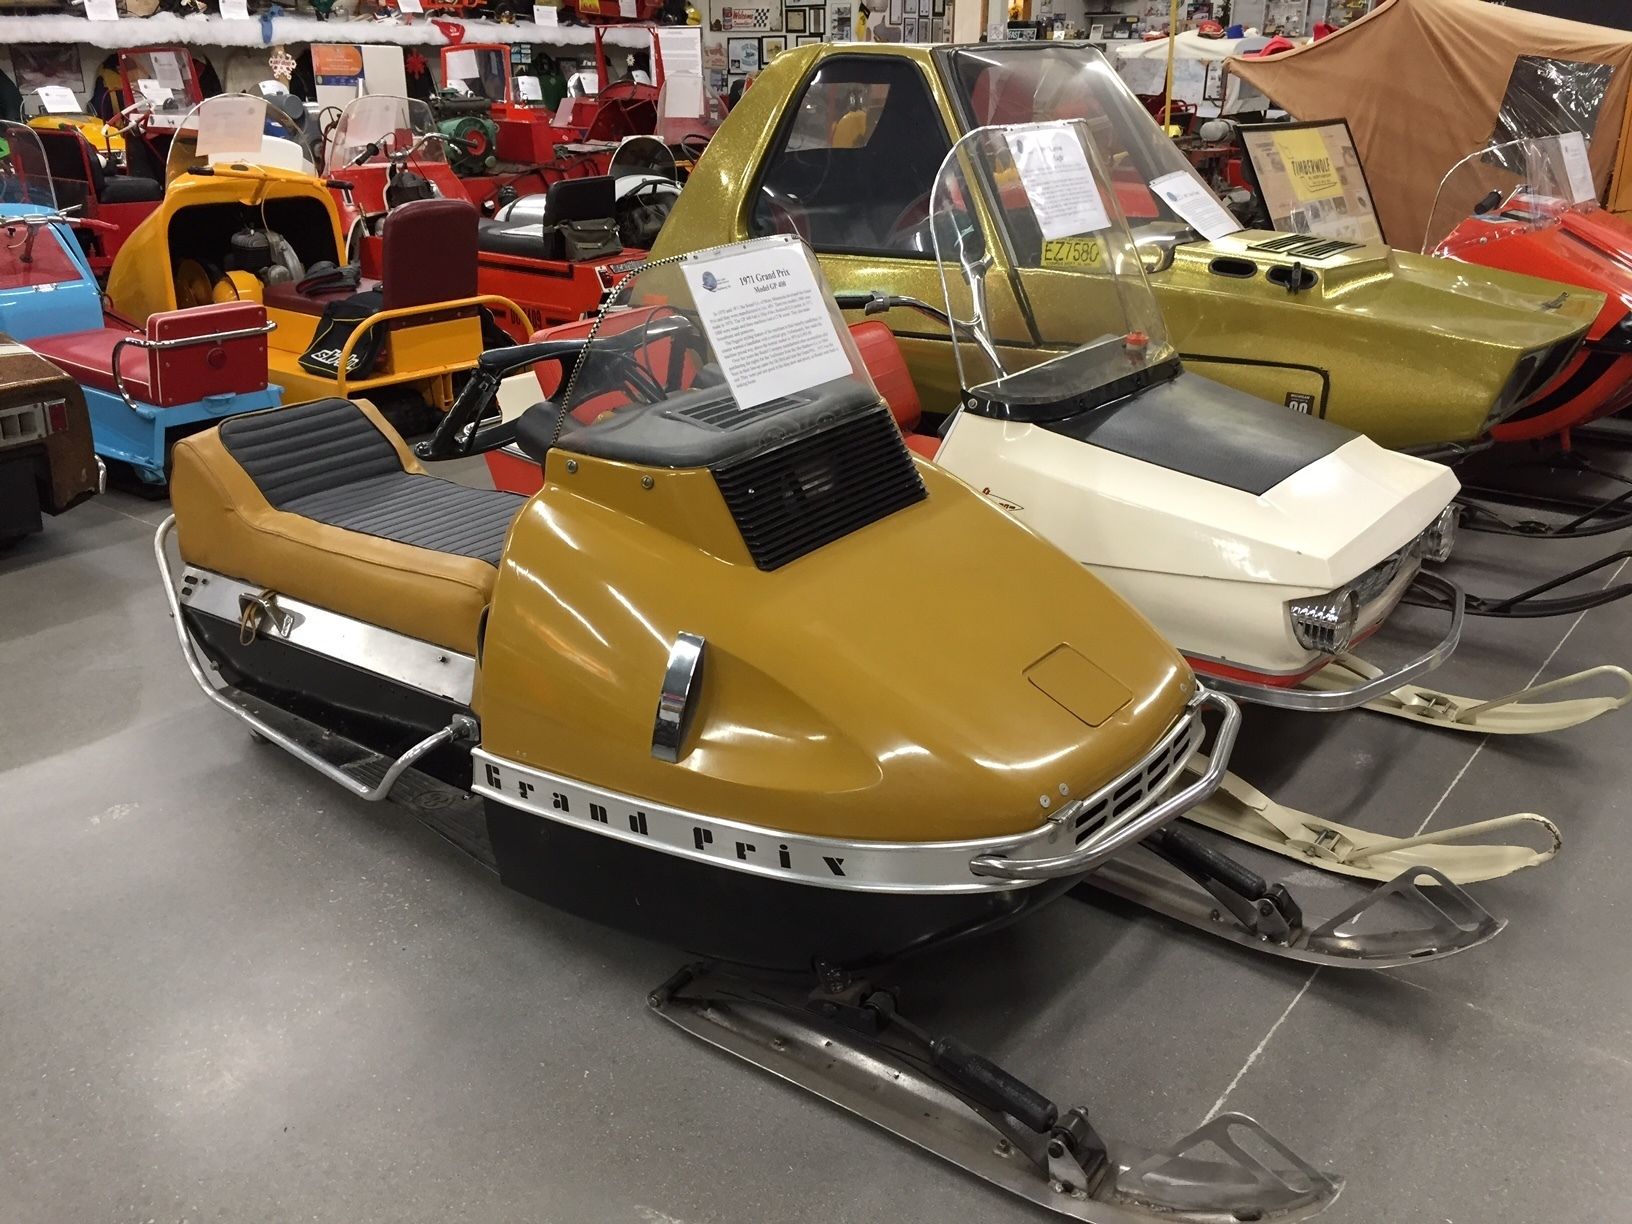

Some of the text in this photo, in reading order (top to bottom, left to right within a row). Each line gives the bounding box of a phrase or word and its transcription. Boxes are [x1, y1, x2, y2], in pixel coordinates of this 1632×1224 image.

[1291, 157, 1330, 176] TIMBERWOLF
[1044, 241, 1099, 263] EZ7580
[739, 275, 755, 286] 1971
[755, 270, 776, 282] Grand
[776, 268, 791, 279] Prix
[753, 284, 769, 293] Model
[769, 282, 778, 290] GP
[485, 763, 846, 877] Grand Prix
